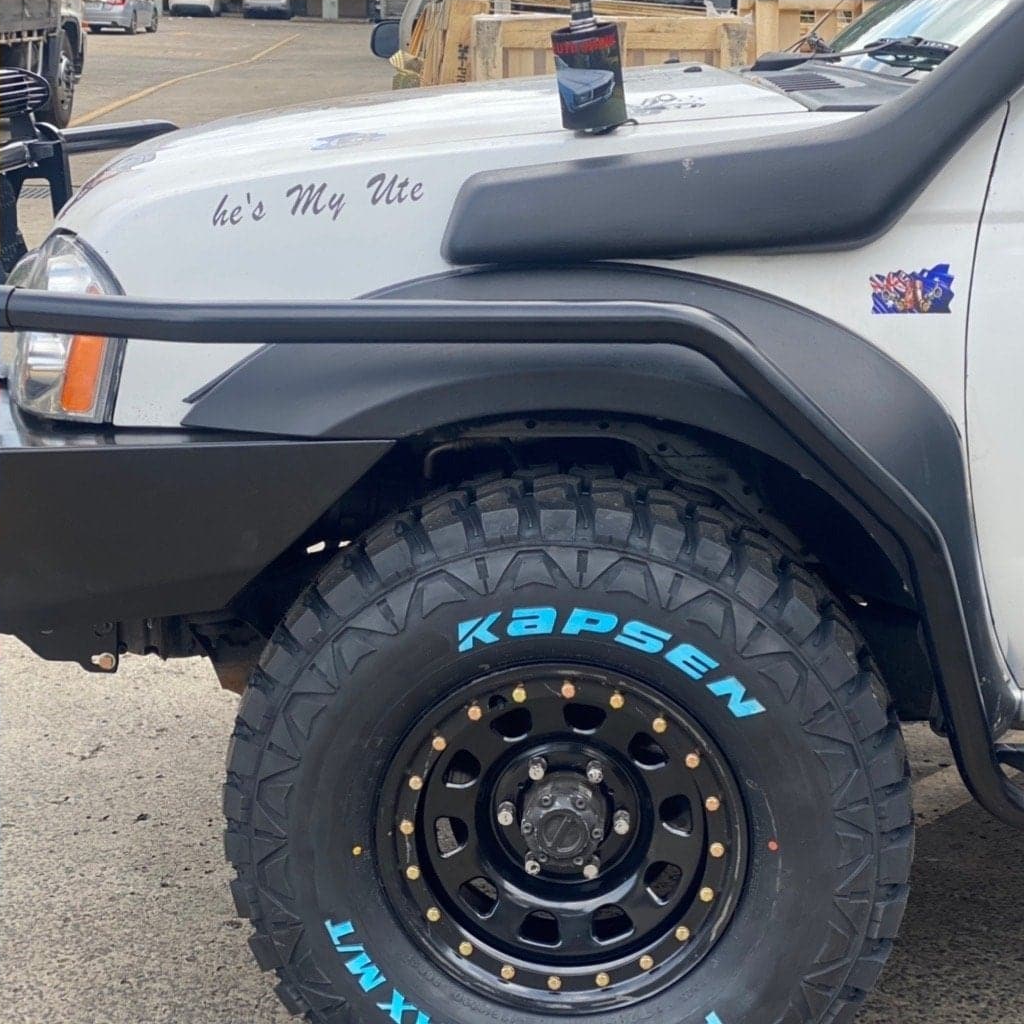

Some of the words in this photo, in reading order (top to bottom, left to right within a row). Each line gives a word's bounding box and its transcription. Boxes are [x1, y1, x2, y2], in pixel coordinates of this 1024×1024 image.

[212, 191, 267, 227] he's
[286, 182, 347, 222] My
[366, 172, 425, 206] Ute
[324, 918, 387, 993] M/T
